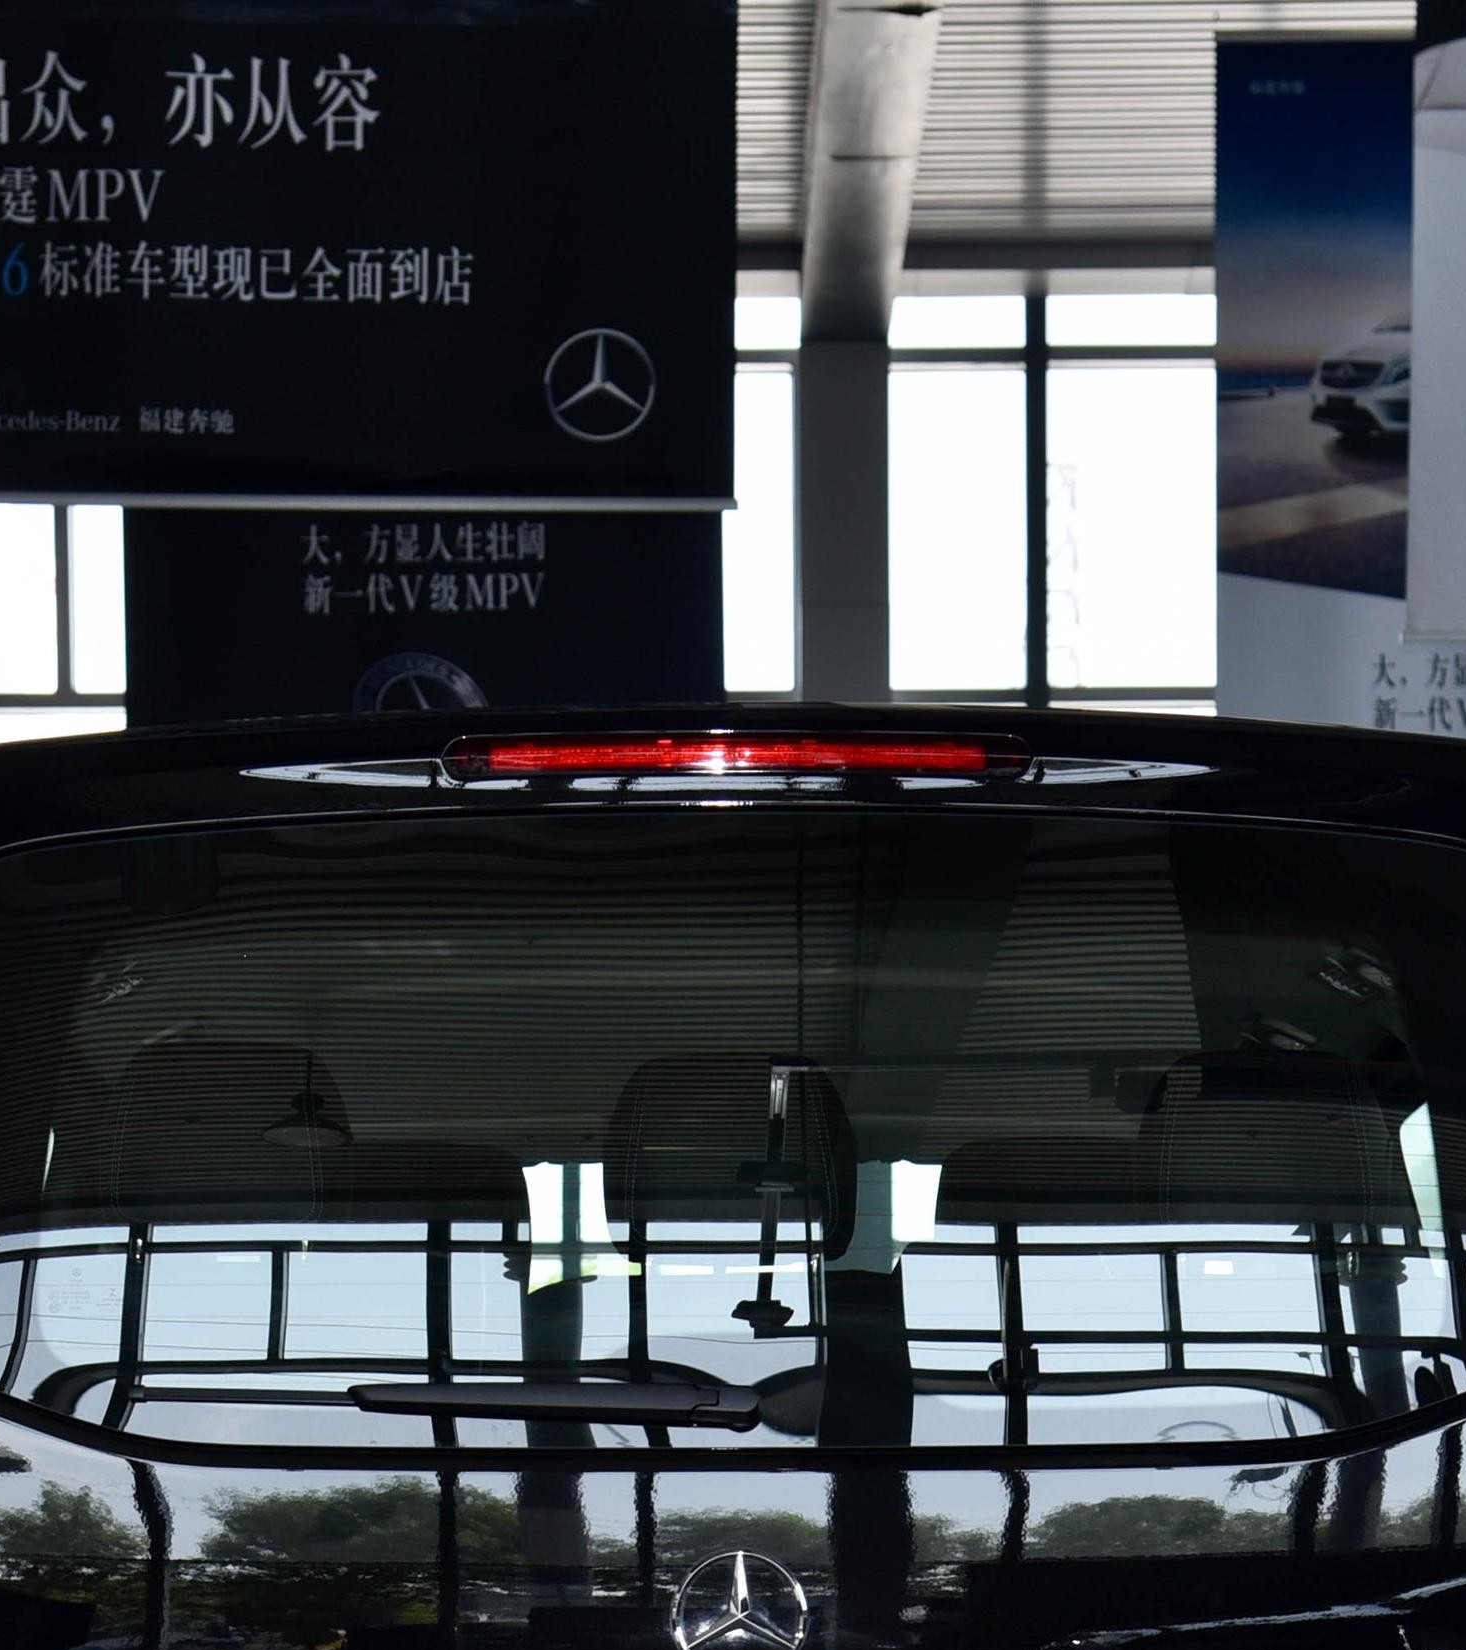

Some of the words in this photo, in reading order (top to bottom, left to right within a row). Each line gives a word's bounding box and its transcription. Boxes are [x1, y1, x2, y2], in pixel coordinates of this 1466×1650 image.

[139, 406, 235, 434] 福建奔驰
[300, 521, 545, 565] 大，方显人生壮阔
[303, 572, 545, 614] 新一代V级MPV
